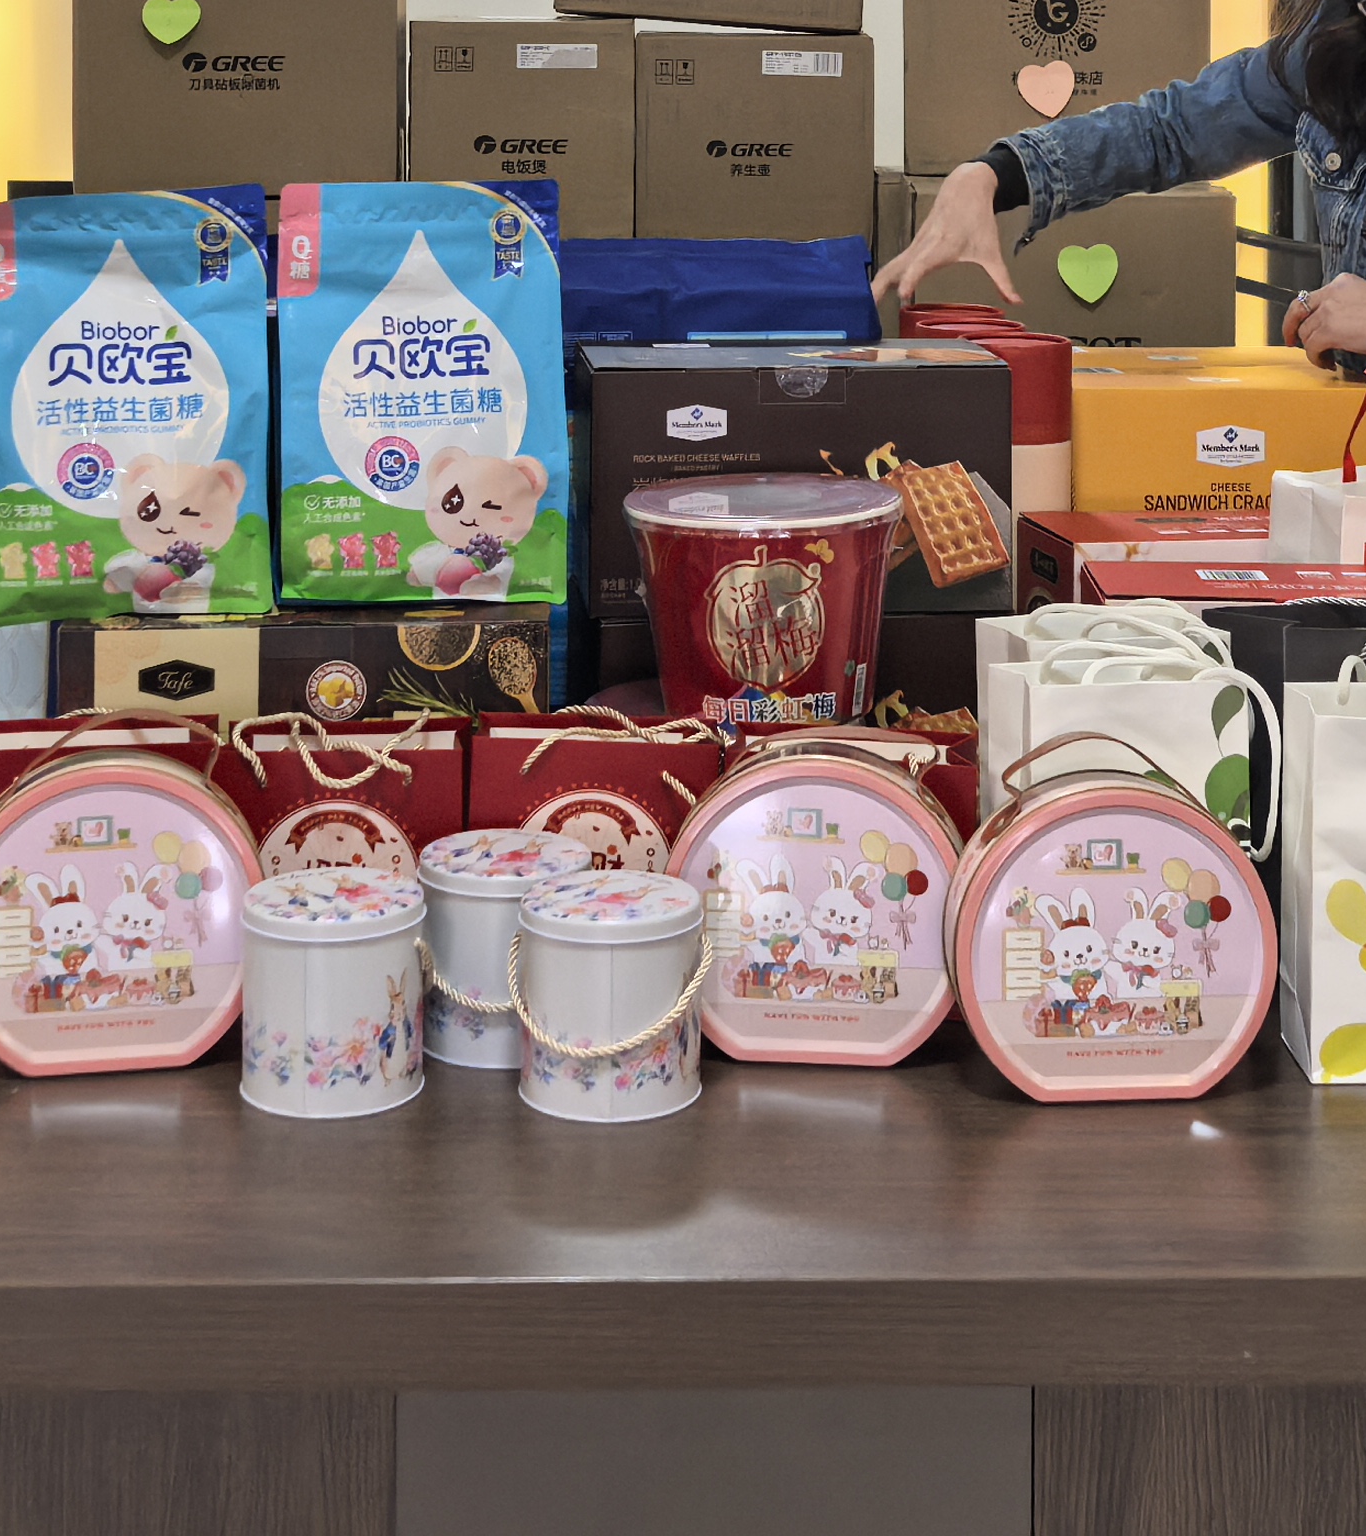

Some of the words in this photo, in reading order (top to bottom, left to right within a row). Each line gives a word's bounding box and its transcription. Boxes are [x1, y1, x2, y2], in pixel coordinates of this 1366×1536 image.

[211, 55, 285, 73] GREE
[189, 77, 281, 92] 刀具砧板除菌机
[500, 139, 568, 155] GREE
[731, 142, 794, 157] GREE
[501, 159, 547, 175] 电饭煲
[730, 163, 771, 177] 养生壶
[290, 261, 311, 280] 糖
[81, 320, 160, 341] Biobor
[382, 315, 458, 336] Biobor
[48, 341, 192, 386] 贝欧宝
[353, 334, 491, 380] 贝欧宝
[37, 393, 204, 426] 活性益生菌糖
[344, 387, 503, 418] 活性益生菌糖
[367, 420, 396, 429] ACTIVE
[453, 416, 486, 426] GUMMY
[1201, 444, 1238, 452] Member's
[1239, 444, 1260, 452] Mark
[633, 454, 655, 463] ROCK
[657, 454, 685, 463] BAKED
[687, 454, 720, 462] CHEESE
[721, 453, 761, 462] WAFFLES
[1211, 482, 1251, 492] CHEESE
[322, 495, 361, 509] 无添加
[1144, 494, 1228, 511] SANDWICH
[13, 504, 53, 517] 无添加
[702, 692, 836, 724] 每日彩虹梅
